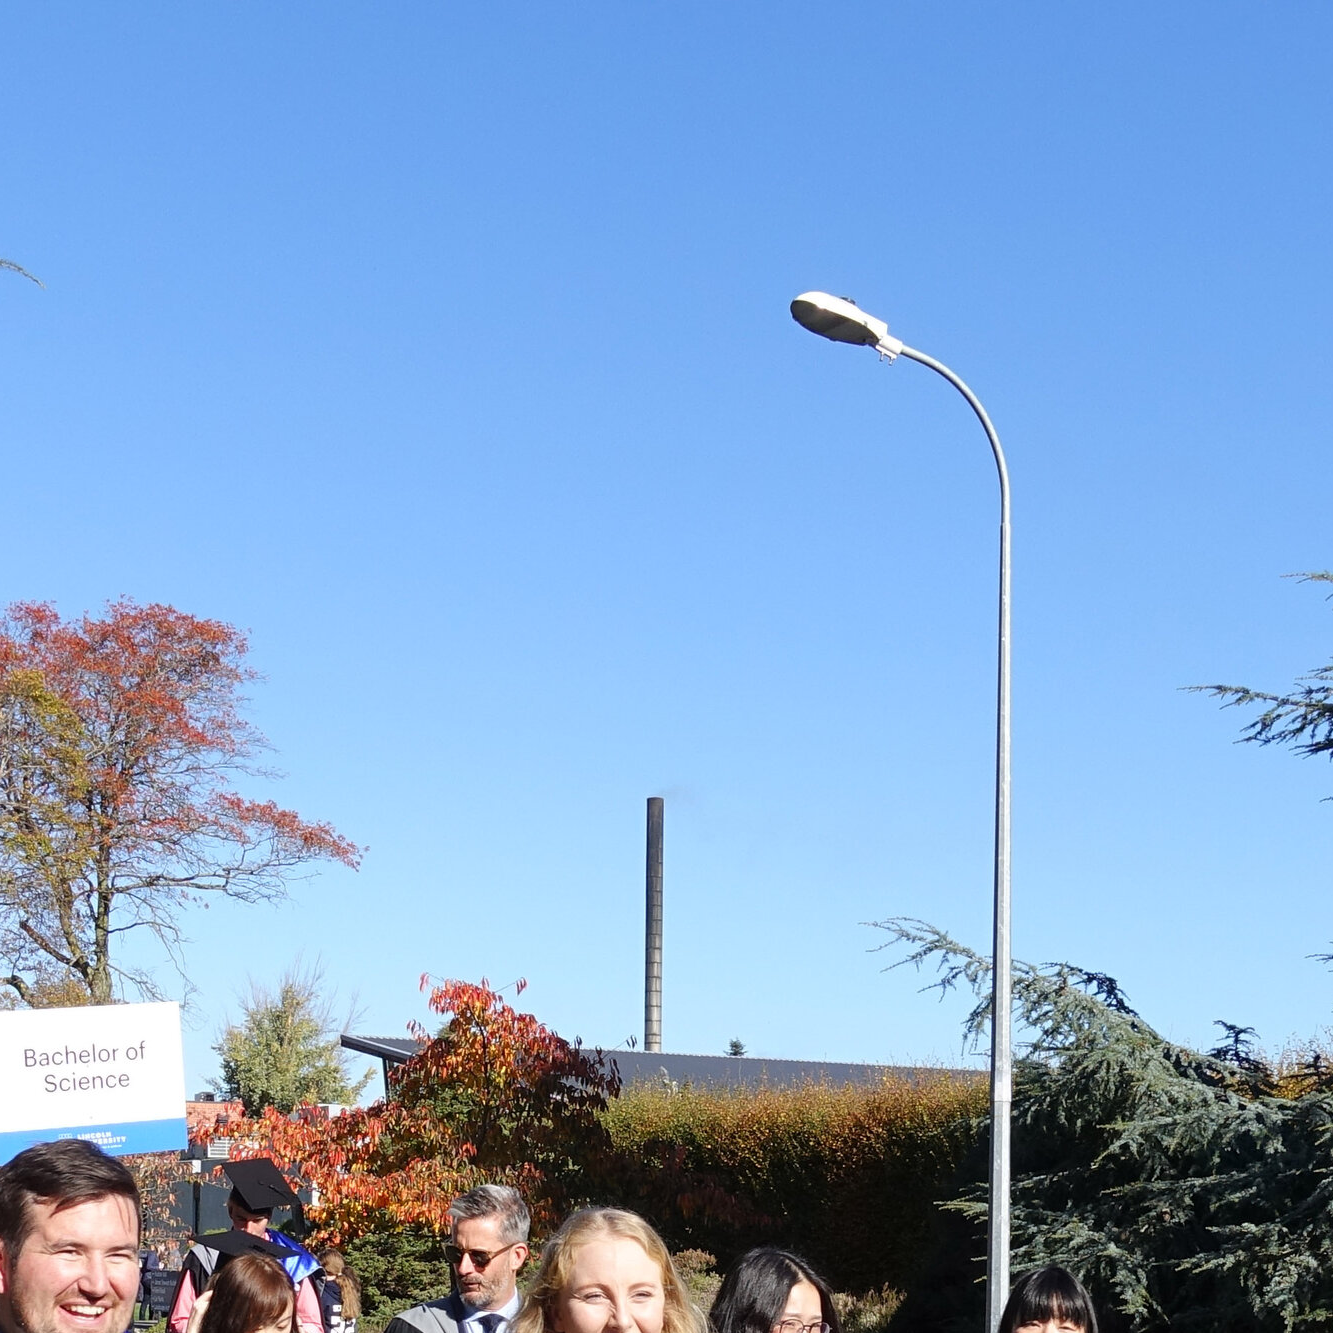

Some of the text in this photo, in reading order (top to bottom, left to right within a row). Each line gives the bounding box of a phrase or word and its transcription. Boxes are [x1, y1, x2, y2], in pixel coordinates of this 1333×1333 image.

[23, 1040, 145, 1067] Bachelor of
[44, 1071, 130, 1093] Science
[76, 1131, 112, 1140] LINCOLN
